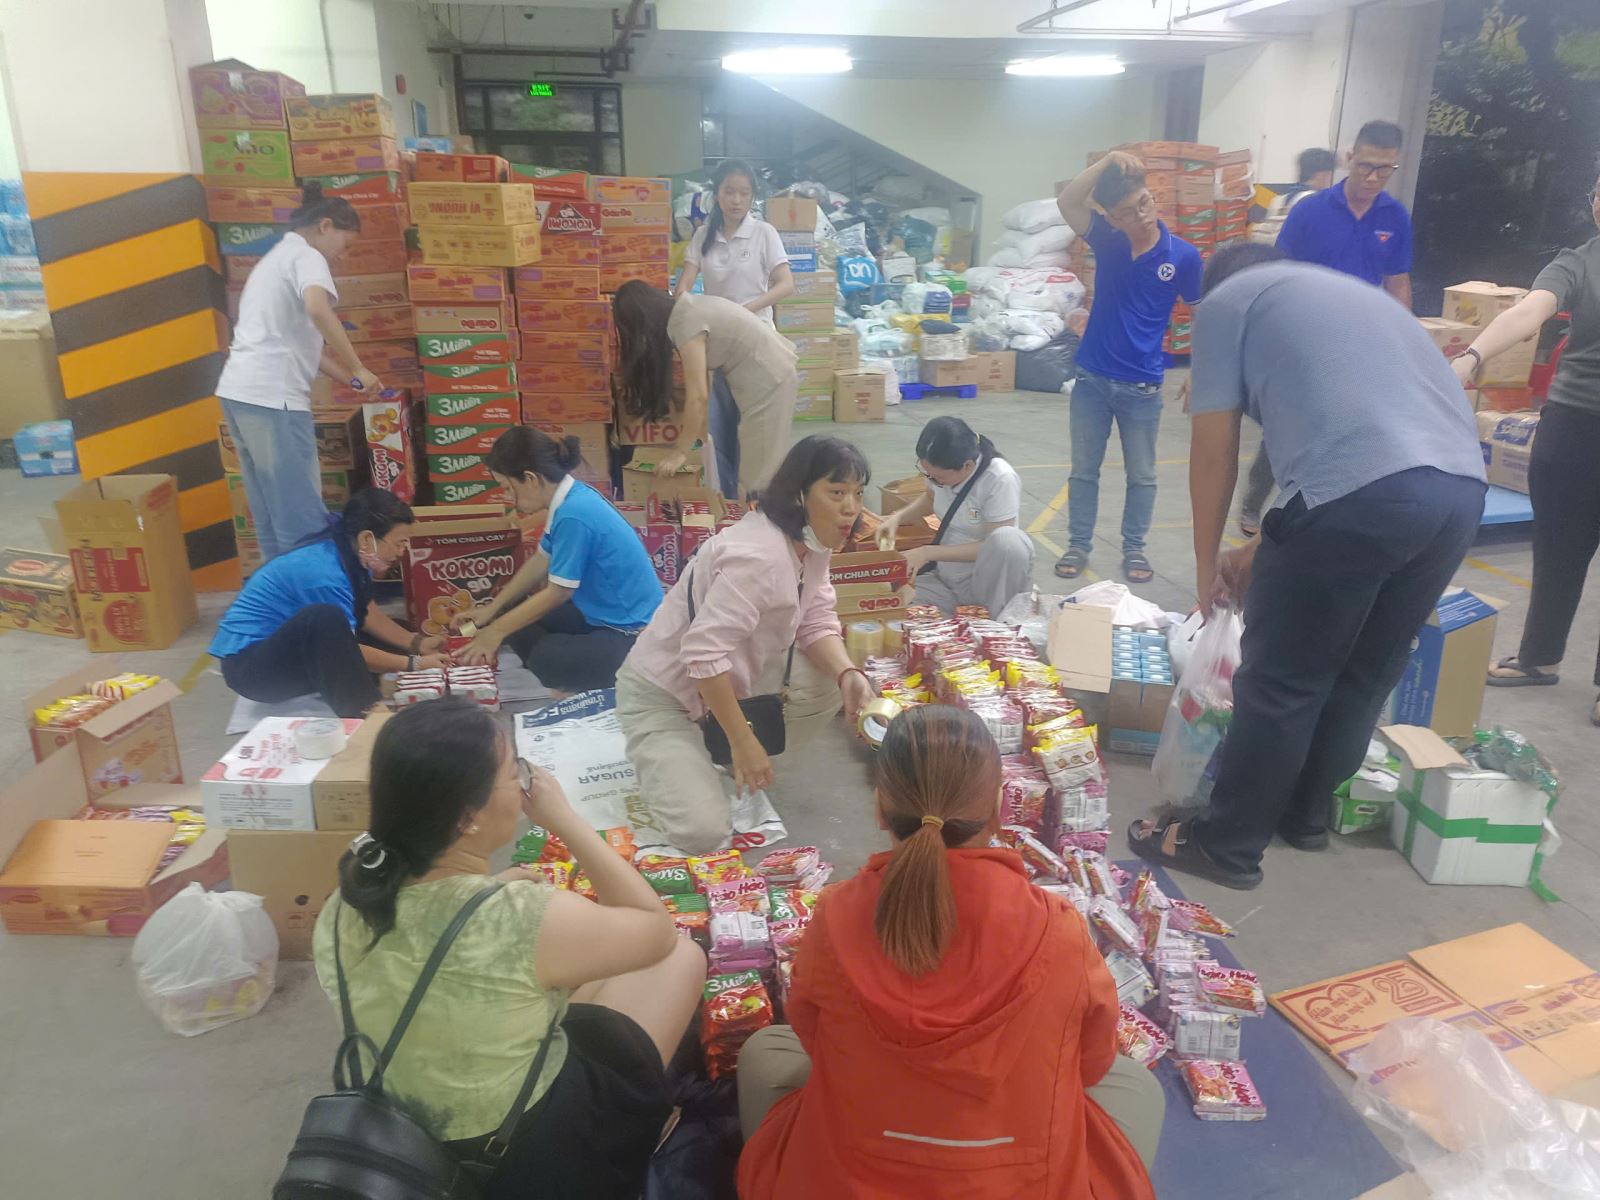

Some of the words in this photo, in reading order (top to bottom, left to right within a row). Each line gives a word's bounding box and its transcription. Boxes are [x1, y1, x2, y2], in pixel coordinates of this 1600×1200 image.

[547, 217, 593, 231] KOKOMI
[624, 422, 683, 443] VIFO
[372, 448, 391, 489] OKOMI
[663, 533, 678, 581] KOKOMI
[429, 555, 514, 580] KOKOMI
[844, 570, 870, 579] CHUA
[872, 567, 890, 576] CAY
[467, 577, 492, 593] 90
[578, 768, 635, 784] SUGAR
